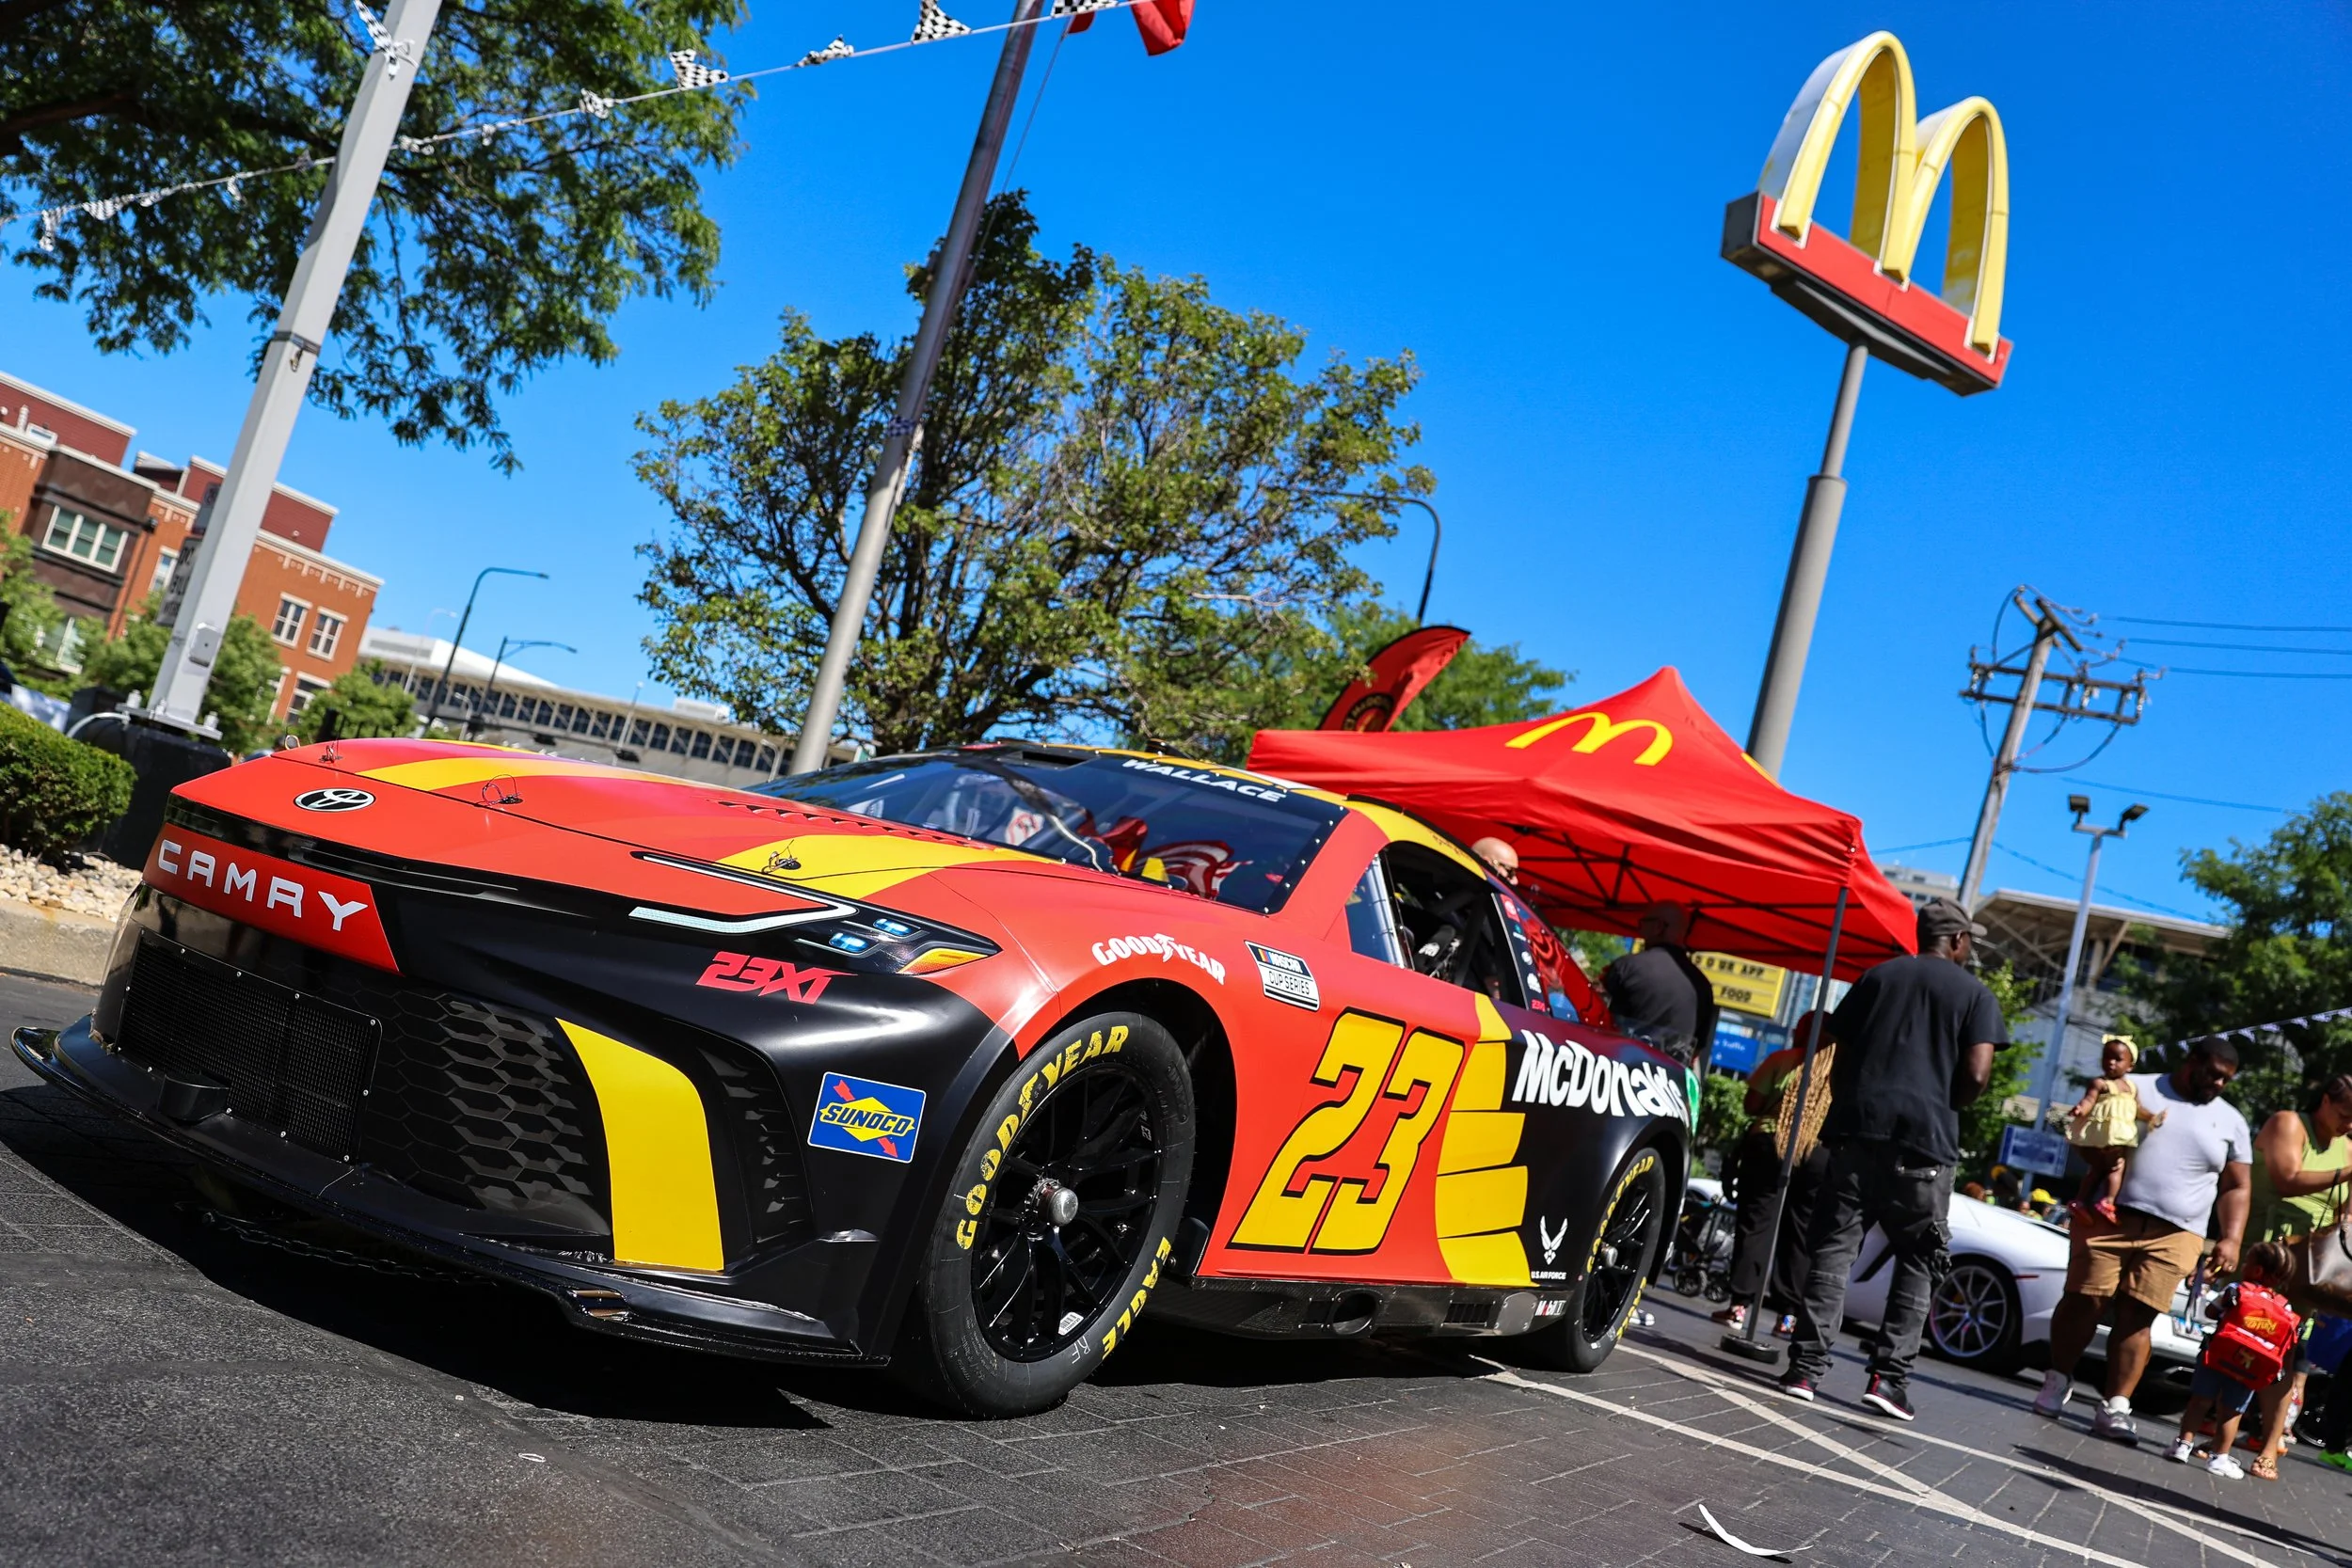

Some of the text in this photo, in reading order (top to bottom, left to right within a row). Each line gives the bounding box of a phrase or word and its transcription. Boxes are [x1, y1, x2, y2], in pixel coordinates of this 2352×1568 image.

[1121, 758, 1287, 802] WALLACE
[157, 838, 369, 932] CAMRY
[1091, 933, 1226, 986] GOODYEAR
[1267, 951, 1303, 974] NASCAR
[1268, 971, 1311, 995] CUP SERIES
[1720, 985, 1752, 1002] FOOD
[823, 1104, 913, 1134] SUNOCO
[955, 1024, 1130, 1251] GOODYEAR
[1223, 1006, 1466, 1257] 23
[1101, 1236, 1172, 1360] EAGLE
